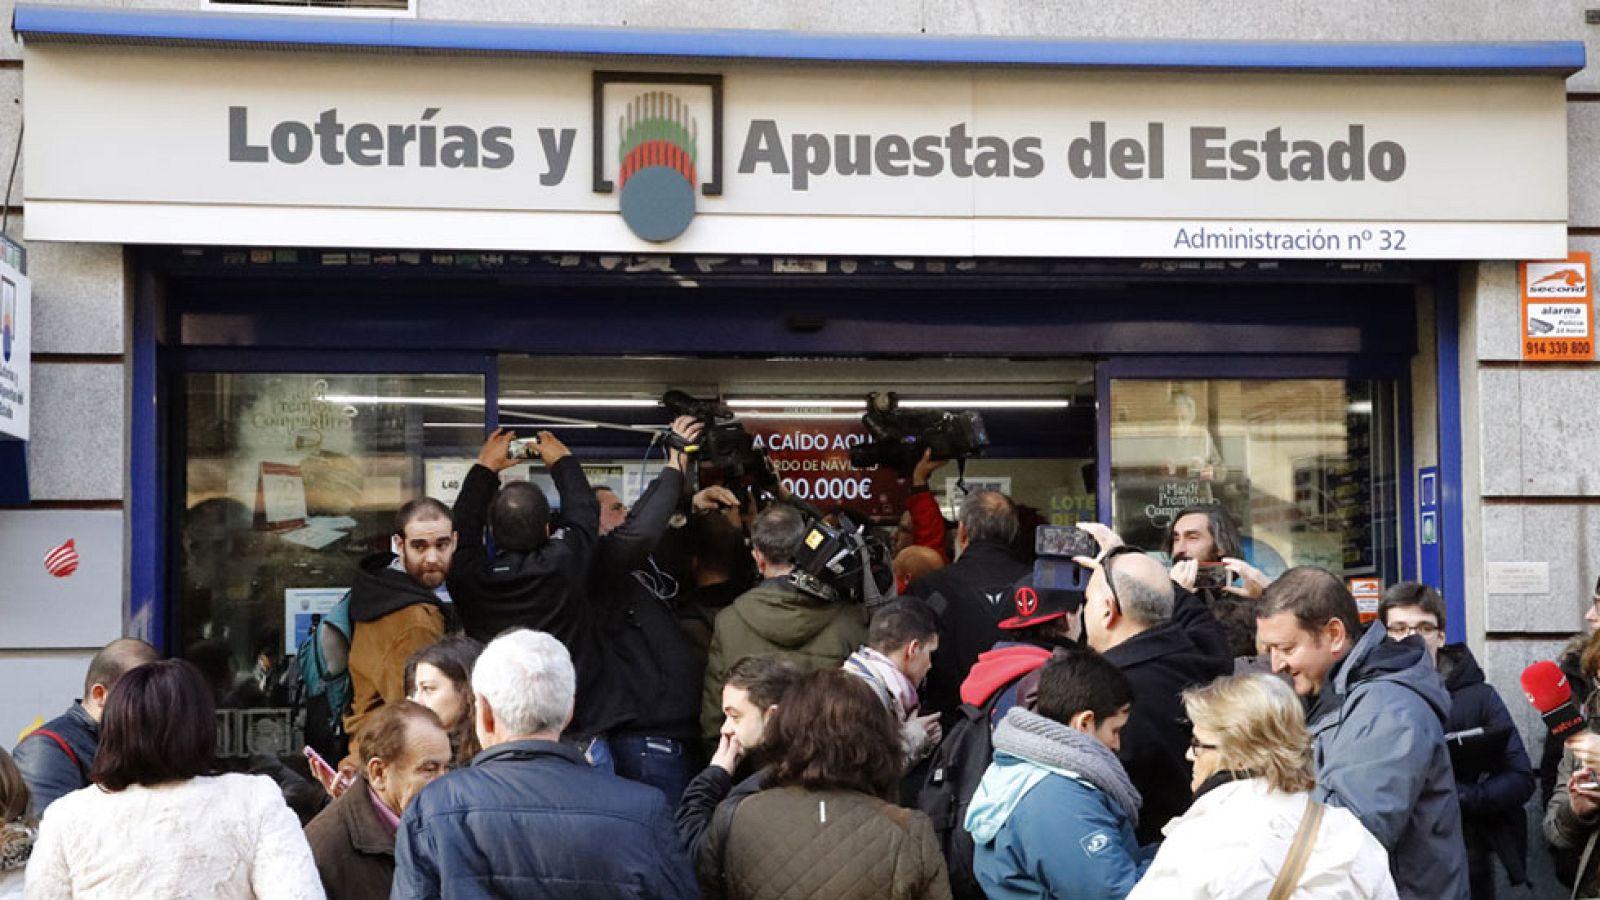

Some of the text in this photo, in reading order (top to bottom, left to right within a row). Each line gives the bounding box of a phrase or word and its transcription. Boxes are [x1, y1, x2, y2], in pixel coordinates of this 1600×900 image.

[229, 106, 1407, 191] Loterías y Apuestas del Estado
[1173, 227, 1340, 250] Administración
[1380, 230, 1407, 250] 32
[1541, 306, 1581, 315] alarma
[1526, 341, 1590, 354] 914 339 800
[752, 431, 873, 450] A CAÍDO AQU
[773, 459, 801, 471] RDO
[802, 459, 818, 471] DE
[1050, 495, 1096, 510] LOTE
